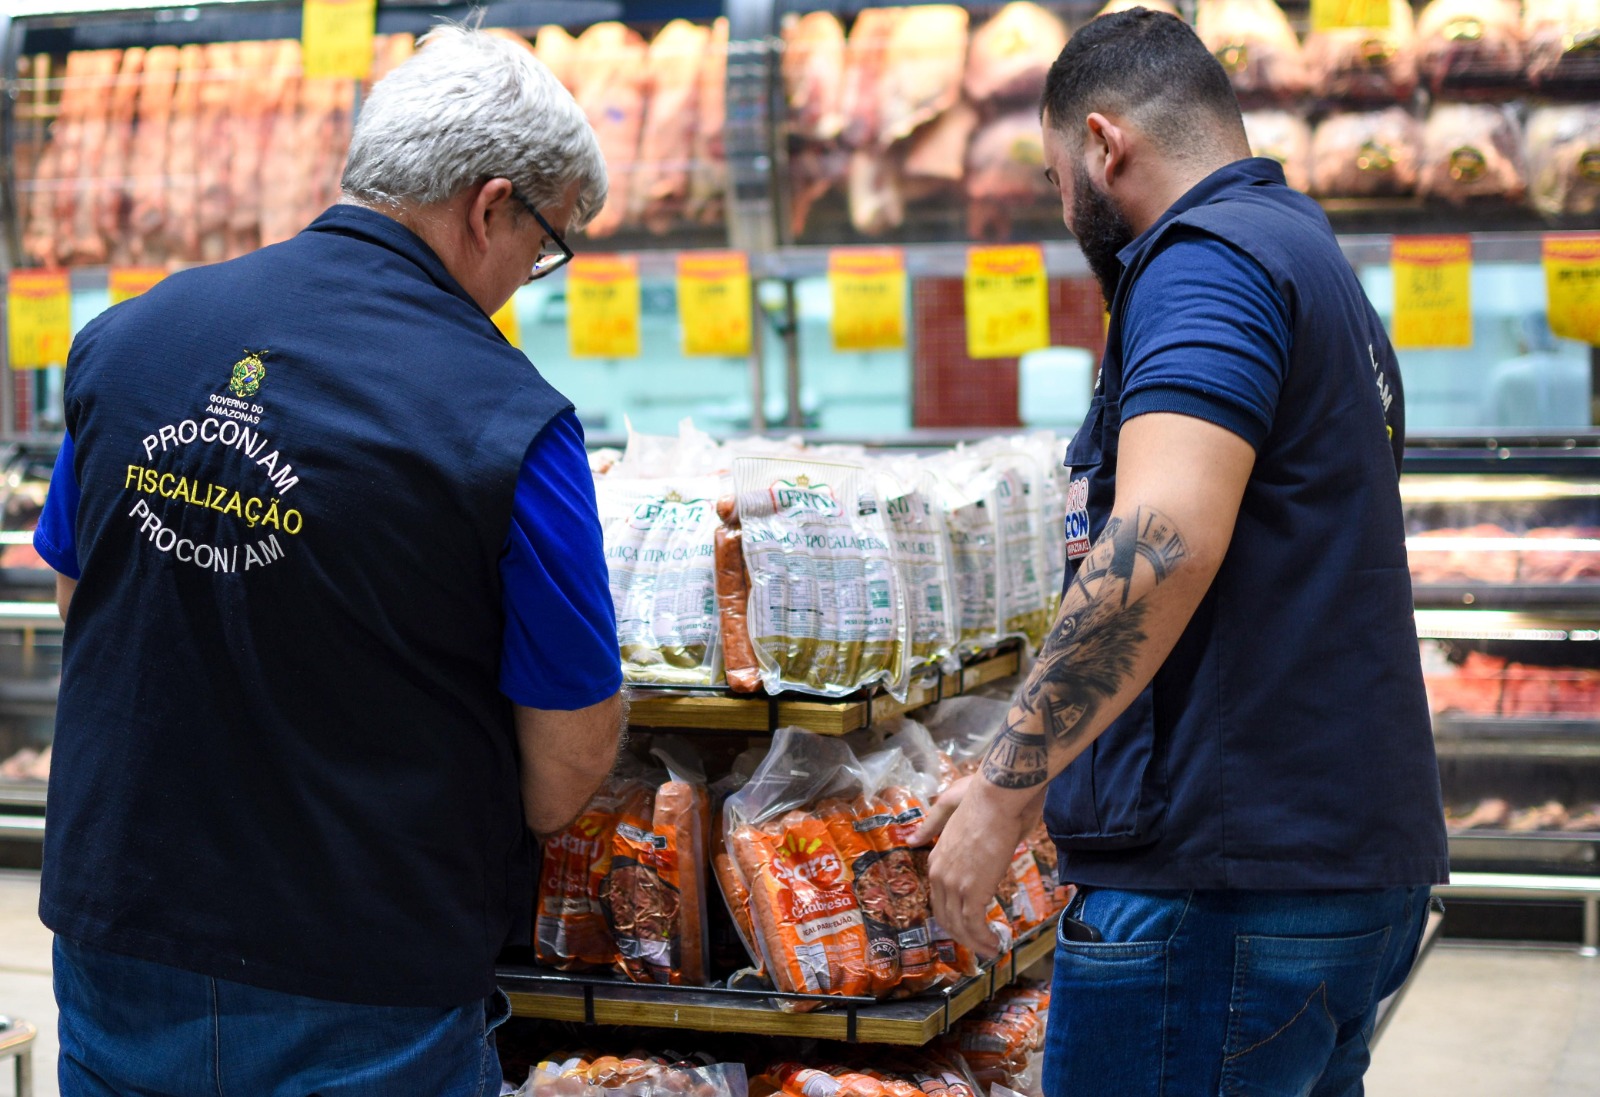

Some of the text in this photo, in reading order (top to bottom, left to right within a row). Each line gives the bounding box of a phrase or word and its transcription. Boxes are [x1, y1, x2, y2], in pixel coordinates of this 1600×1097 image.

[206, 404, 261, 424] AMAZONAS
[209, 393, 264, 414] GOVERNO DO
[125, 464, 303, 535] FISCALIZAÇÃO
[1066, 511, 1088, 539] CON
[805, 534, 826, 548] TIPO
[773, 853, 840, 883] Sara
[792, 897, 852, 919] Clabresa
